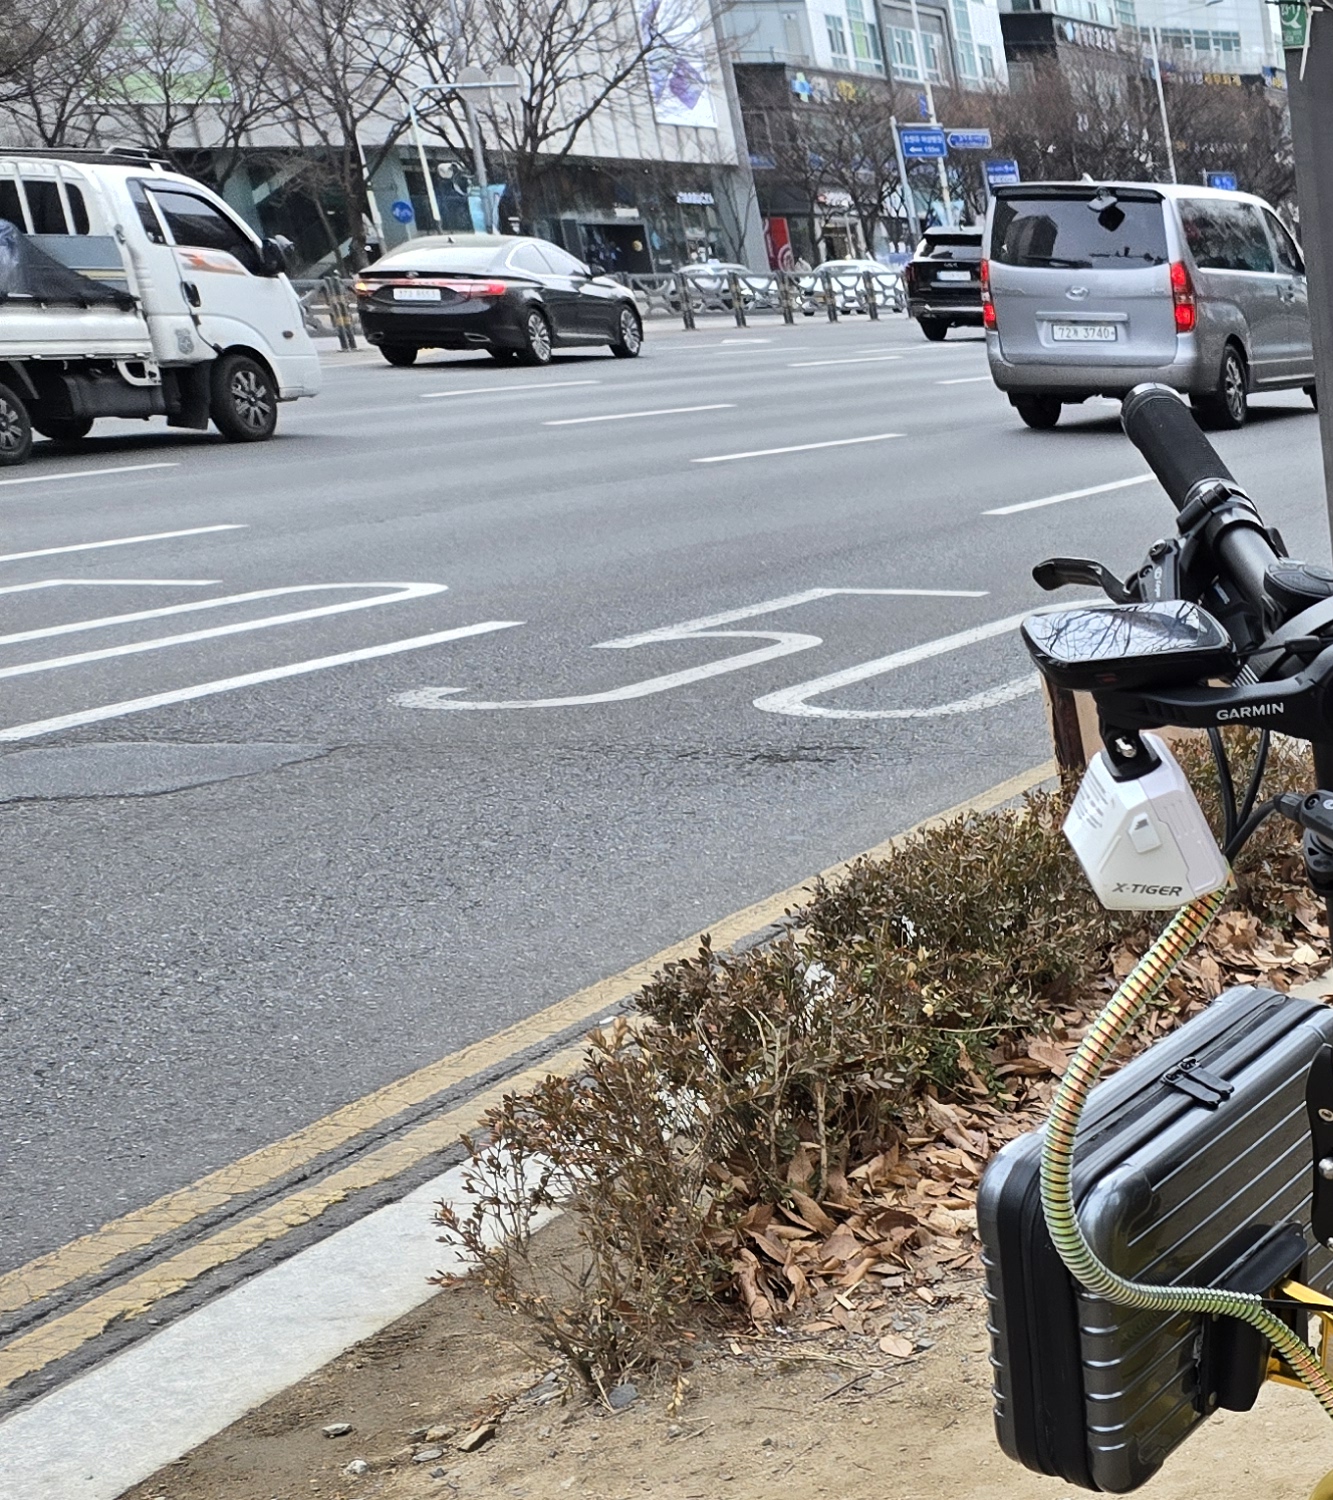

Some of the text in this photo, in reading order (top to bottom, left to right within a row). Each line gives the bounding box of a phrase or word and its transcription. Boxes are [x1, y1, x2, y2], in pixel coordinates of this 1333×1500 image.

[1083, 327, 1110, 339] 3740
[1216, 702, 1285, 721] GARMIN
[1112, 882, 1183, 897] X-TIGER
